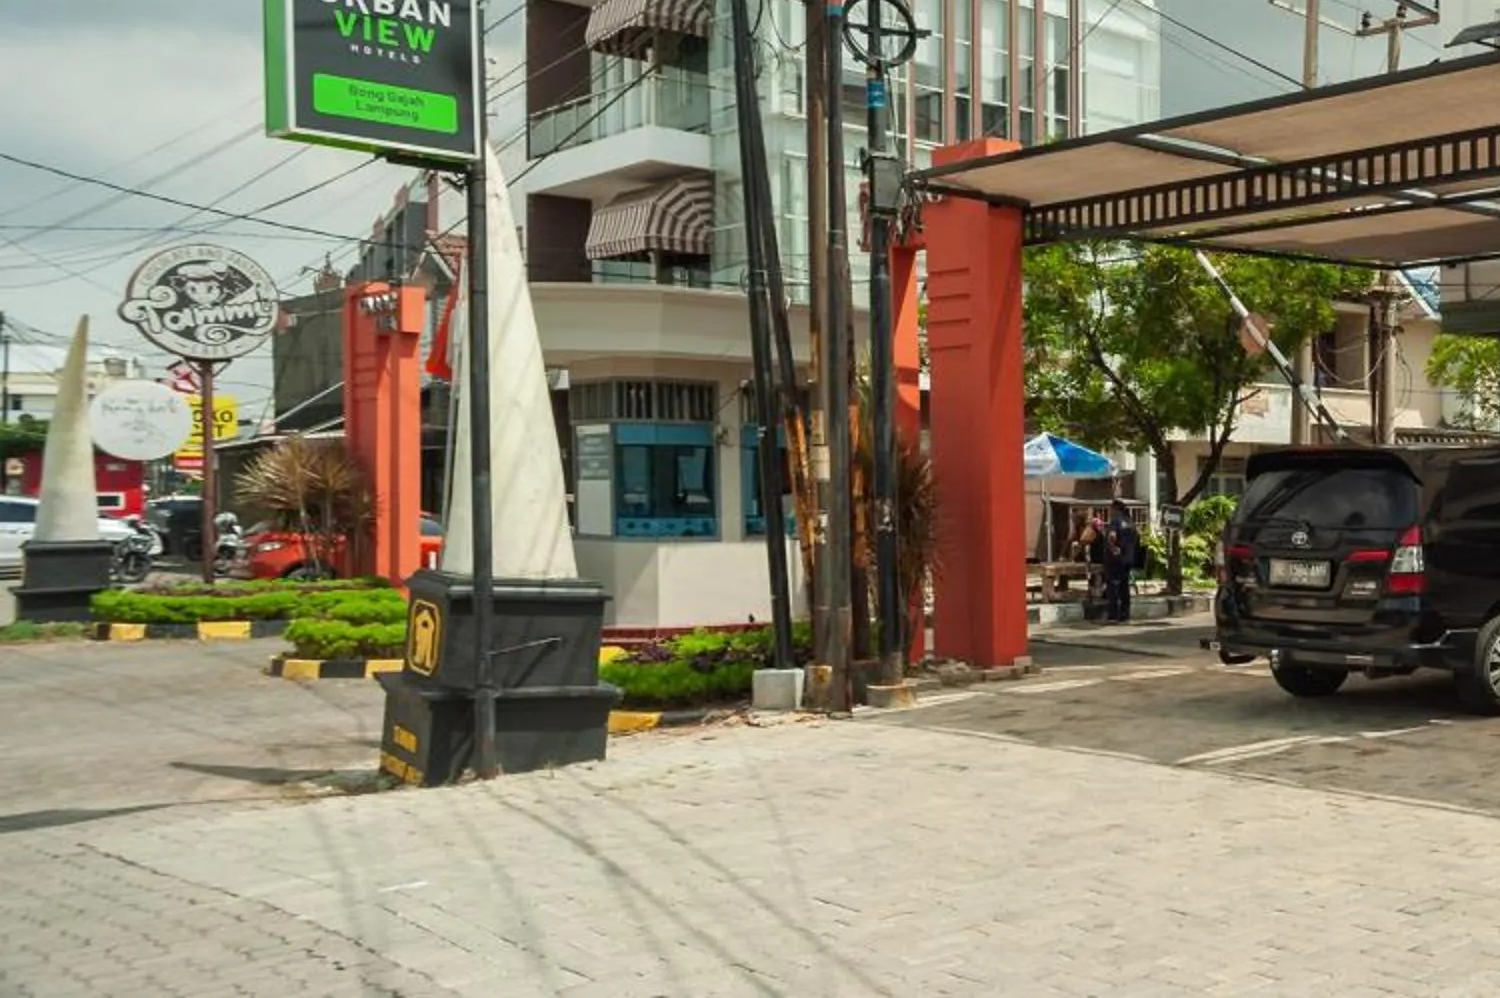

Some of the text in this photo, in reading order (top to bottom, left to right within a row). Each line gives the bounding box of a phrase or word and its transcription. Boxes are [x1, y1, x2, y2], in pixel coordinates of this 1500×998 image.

[334, 8, 437, 53] VIEW
[350, 43, 422, 65] HOTELS
[354, 102, 421, 123] Lampung
